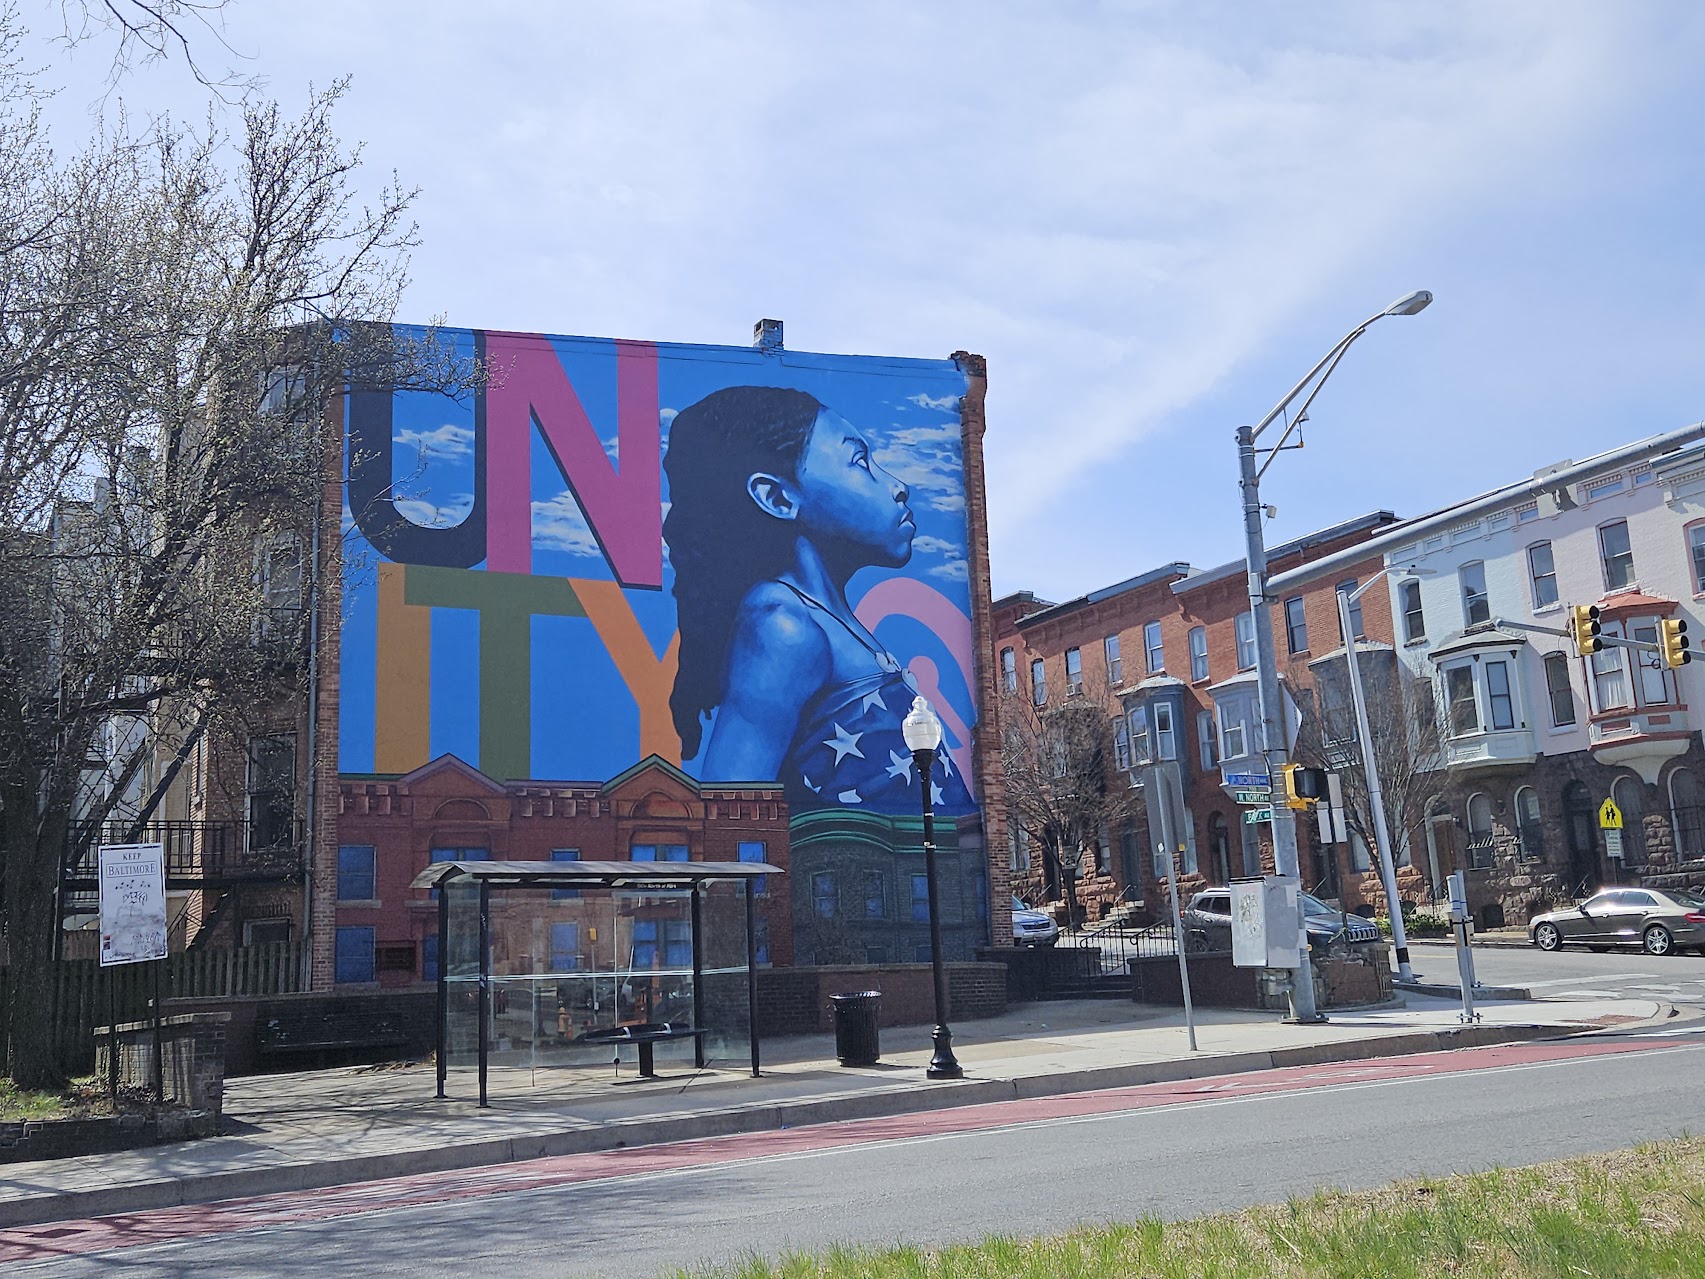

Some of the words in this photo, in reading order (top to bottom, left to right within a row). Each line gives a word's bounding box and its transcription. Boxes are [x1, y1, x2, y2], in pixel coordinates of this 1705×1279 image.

[1238, 776, 1260, 785] NORTH
[1245, 793, 1264, 802] NORTH
[123, 852, 142, 861] KEEP
